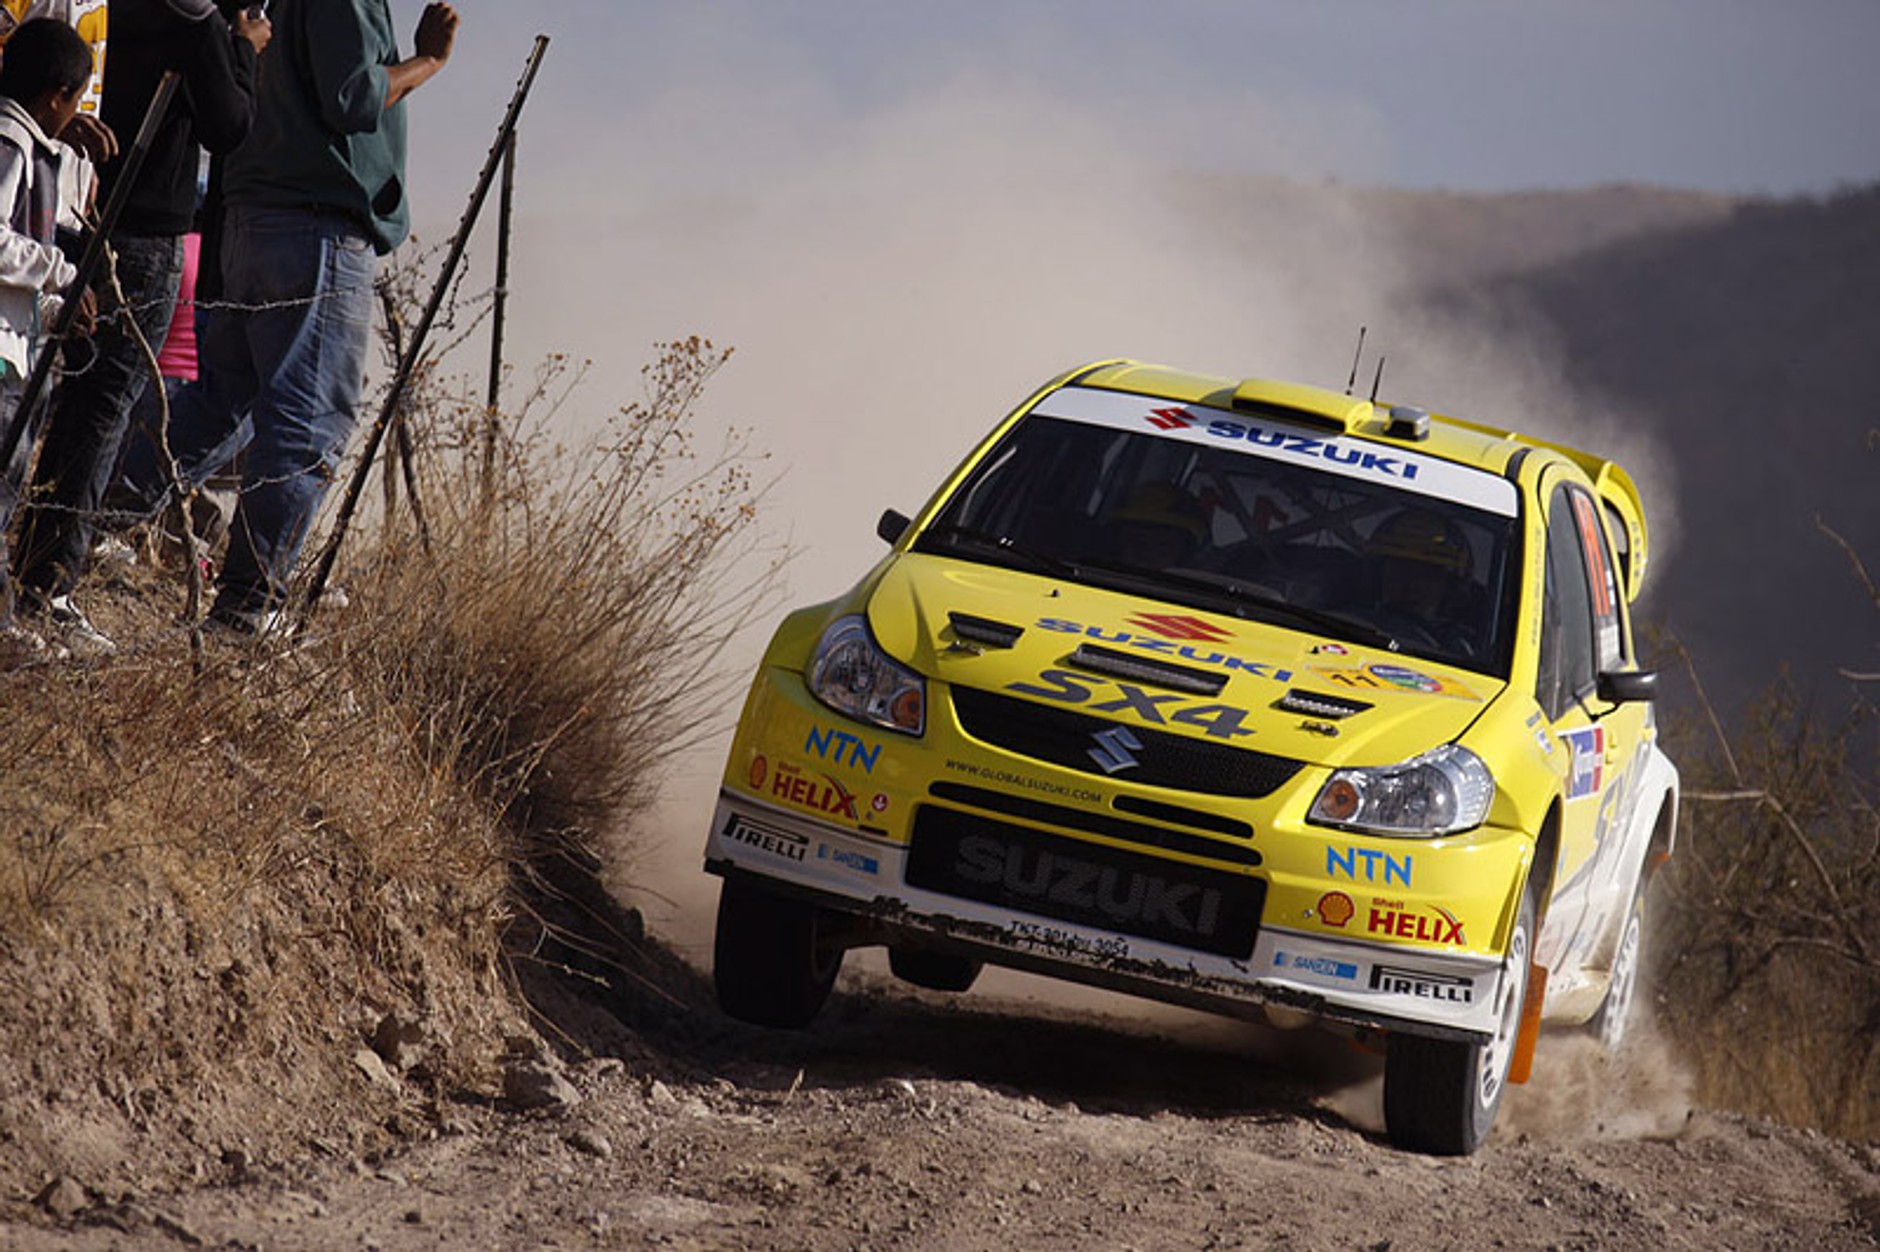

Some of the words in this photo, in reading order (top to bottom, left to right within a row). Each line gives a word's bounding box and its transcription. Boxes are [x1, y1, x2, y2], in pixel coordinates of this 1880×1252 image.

[1207, 420, 1418, 480] SUZUKI
[1035, 618, 1293, 682] SUZUKI
[1003, 669, 1257, 739] SX4
[1332, 674, 1379, 687] 11
[805, 725, 882, 773] NTN
[772, 772, 857, 819] HELIX
[945, 759, 1102, 802] WWW.GLOBALSUZUKI.COM
[722, 812, 809, 861] PIRELLI
[955, 834, 1222, 935] SUZUKI
[1327, 845, 1412, 888] NTN
[1367, 905, 1465, 945] HELIX
[1372, 897, 1404, 910] Shell
[1369, 963, 1474, 1002] PIRELLI
